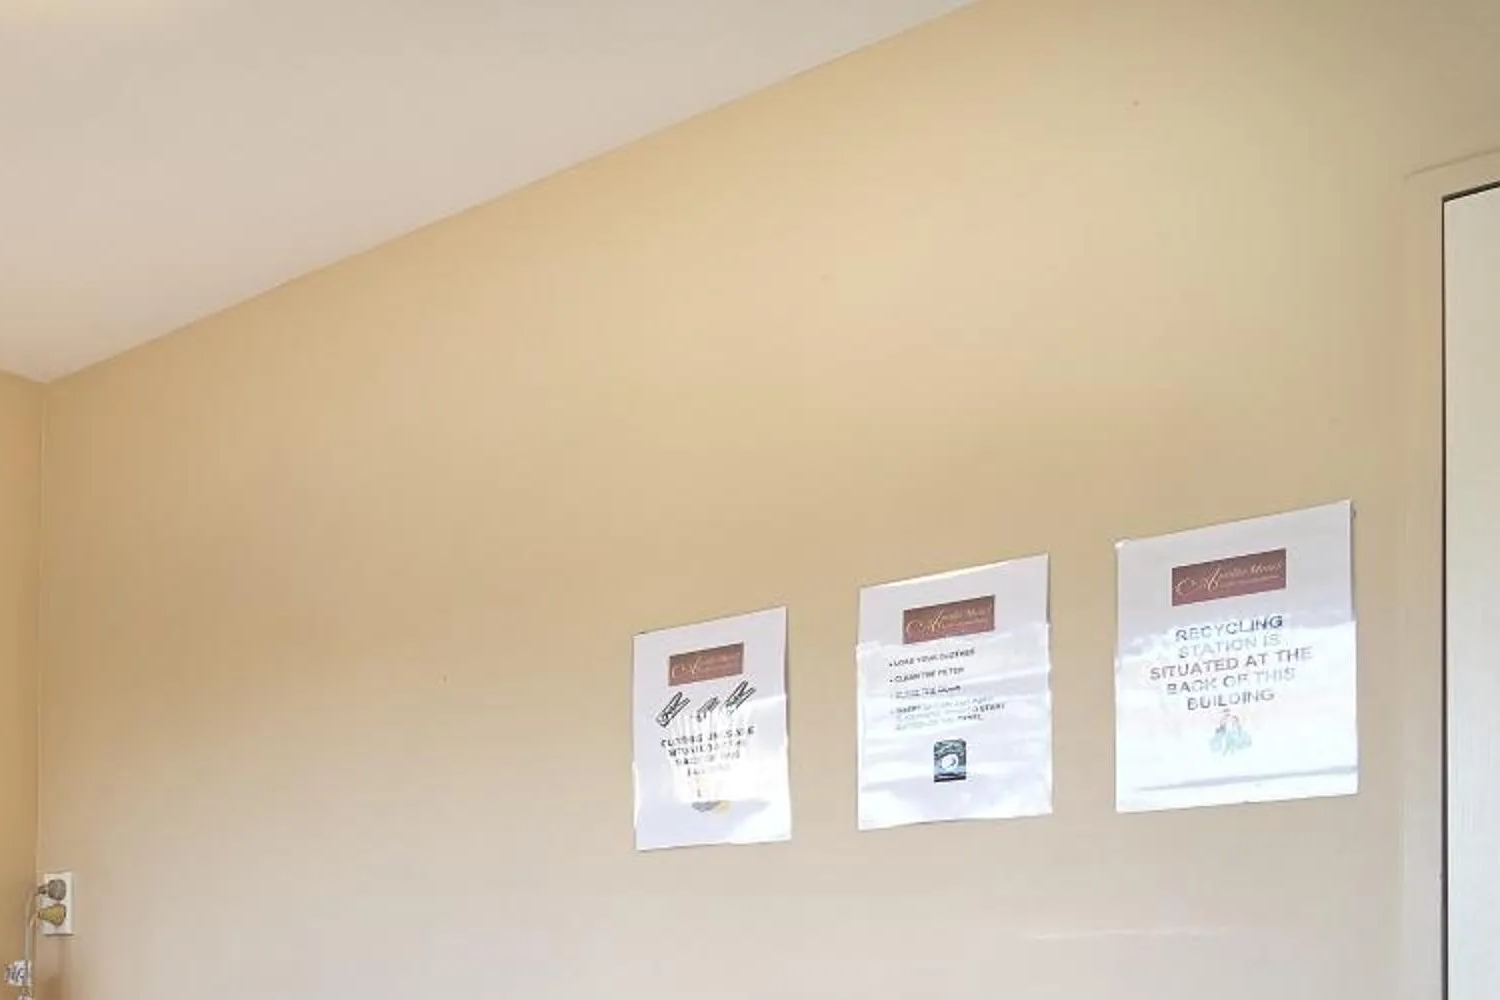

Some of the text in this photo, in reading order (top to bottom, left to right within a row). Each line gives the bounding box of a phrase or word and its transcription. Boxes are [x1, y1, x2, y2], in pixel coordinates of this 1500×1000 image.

[1175, 615, 1283, 642] RECYCLING
[1179, 633, 1281, 659] STATION IS
[1150, 646, 1313, 681] SITUATED AT THE
[1167, 667, 1296, 695] BACK OF THIS
[1187, 690, 1275, 710] BUILDING
